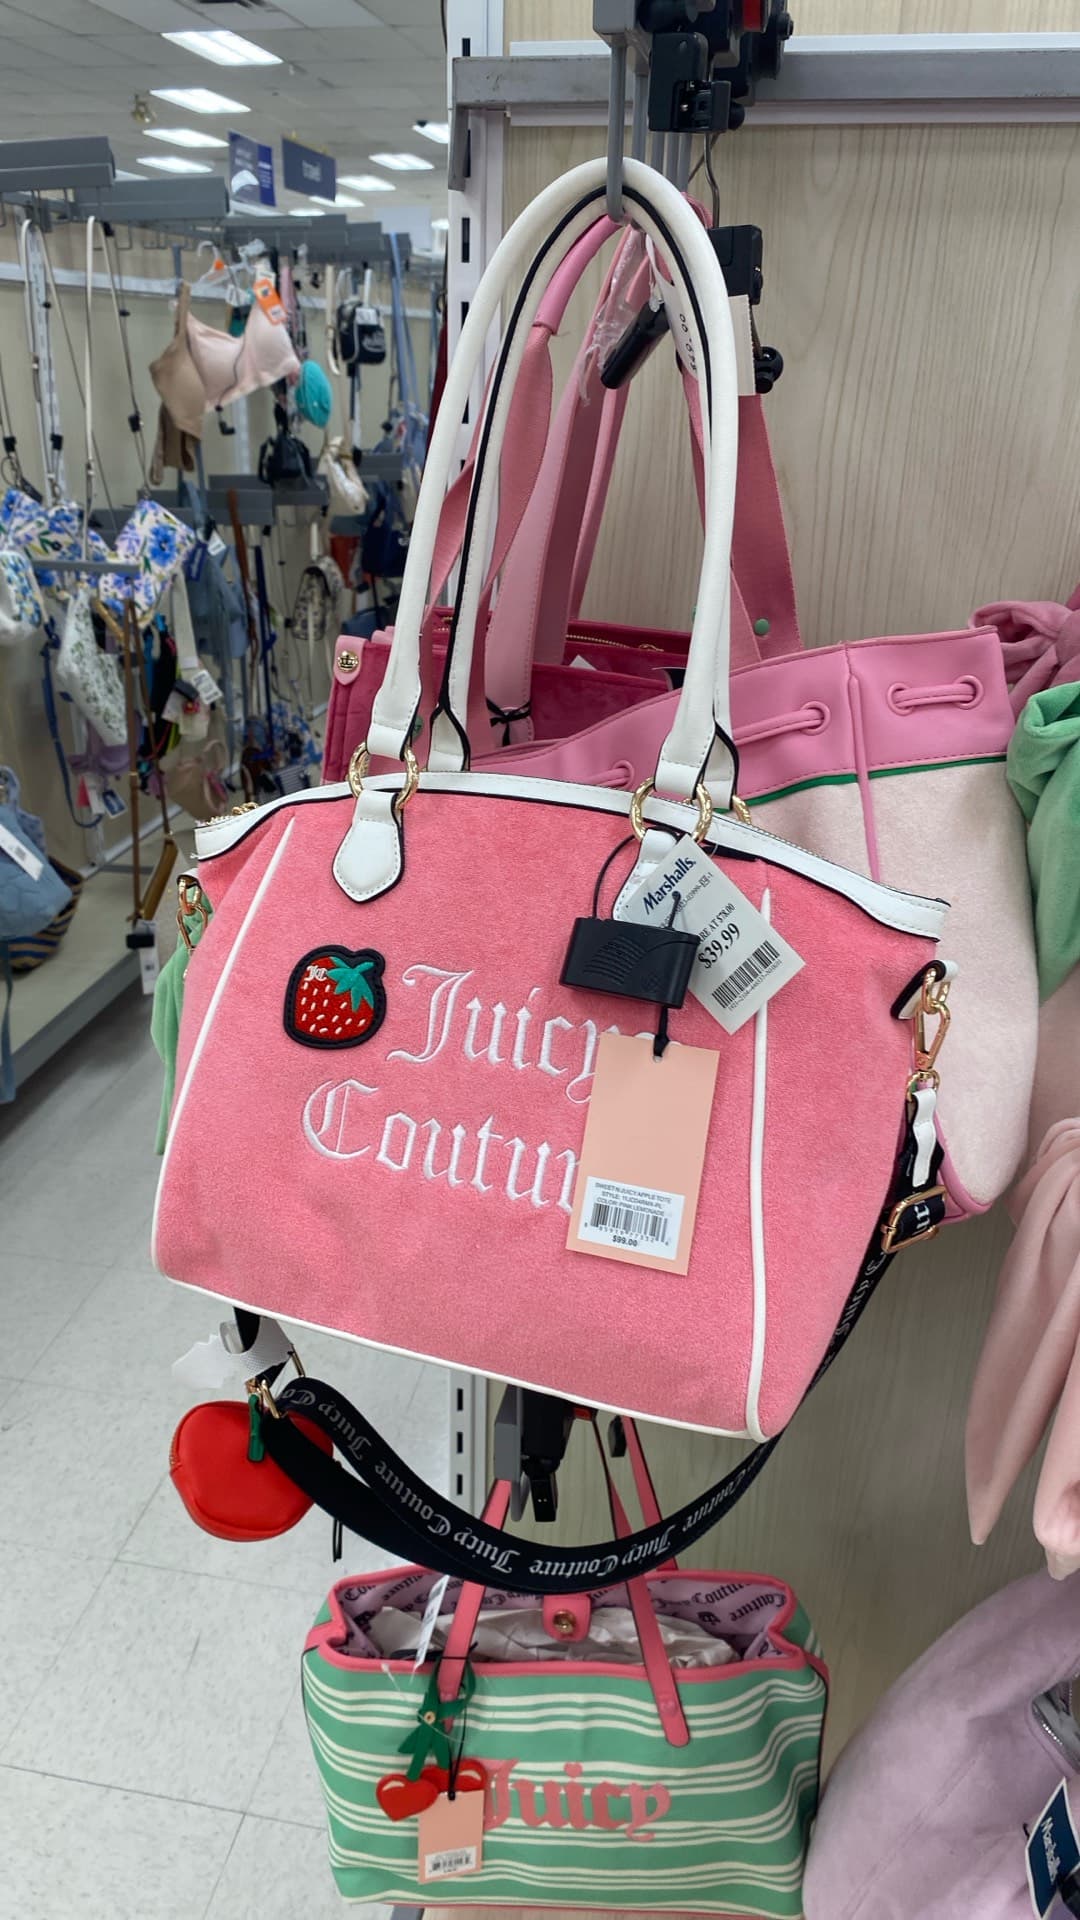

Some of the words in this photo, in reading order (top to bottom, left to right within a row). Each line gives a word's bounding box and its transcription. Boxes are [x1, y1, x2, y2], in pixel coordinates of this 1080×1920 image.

[643, 856, 695, 915] Marshalls
[698, 923, 740, 969] $39.99
[612, 1235, 638, 1247] $99.00
[318, 1401, 373, 1461] Juicy
[374, 1461, 451, 1537] Couture
[453, 1528, 521, 1574] Juicy
[529, 1553, 618, 1578] Couture
[622, 1523, 676, 1565] Juicy
[470, 1757, 671, 1843] Juicy
